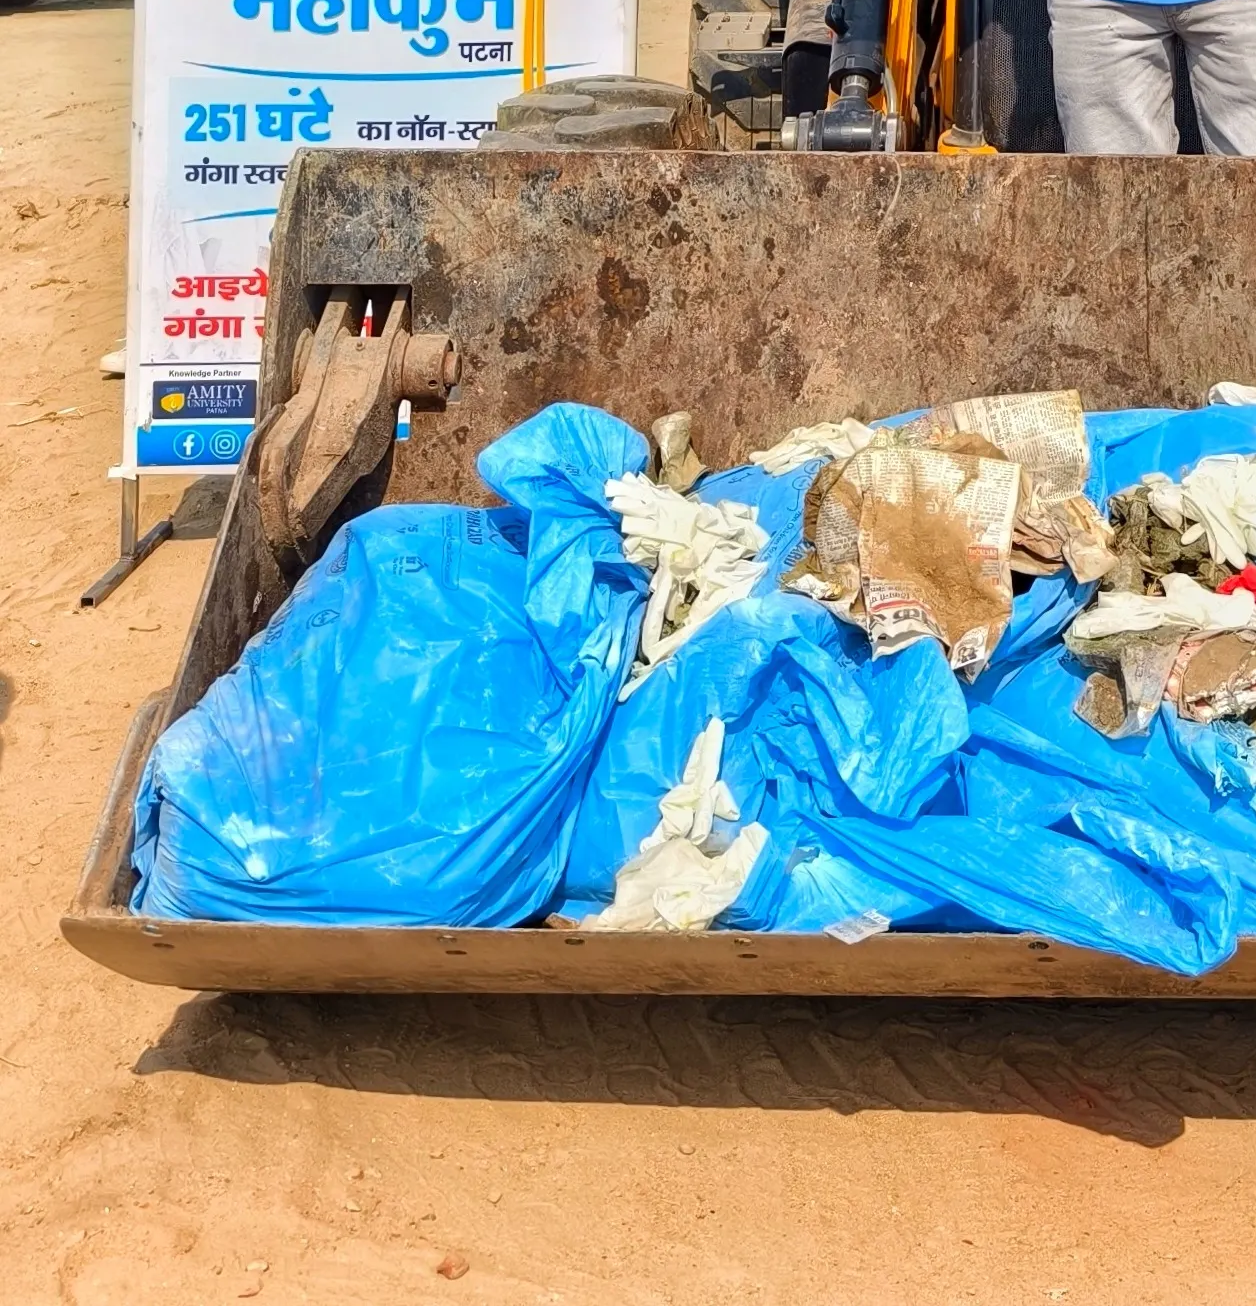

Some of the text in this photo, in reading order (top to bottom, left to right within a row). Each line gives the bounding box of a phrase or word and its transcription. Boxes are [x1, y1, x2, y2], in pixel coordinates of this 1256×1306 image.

[459, 42, 513, 63] पटना
[184, 104, 246, 142] 251
[256, 87, 333, 142] घंटे
[356, 121, 392, 141] का
[184, 156, 239, 184] गंगा
[164, 308, 245, 339] गंगा
[169, 369, 241, 378] Knowledge Partner
[187, 384, 246, 399] AMITY
[187, 399, 243, 408] UNIVERSITY
